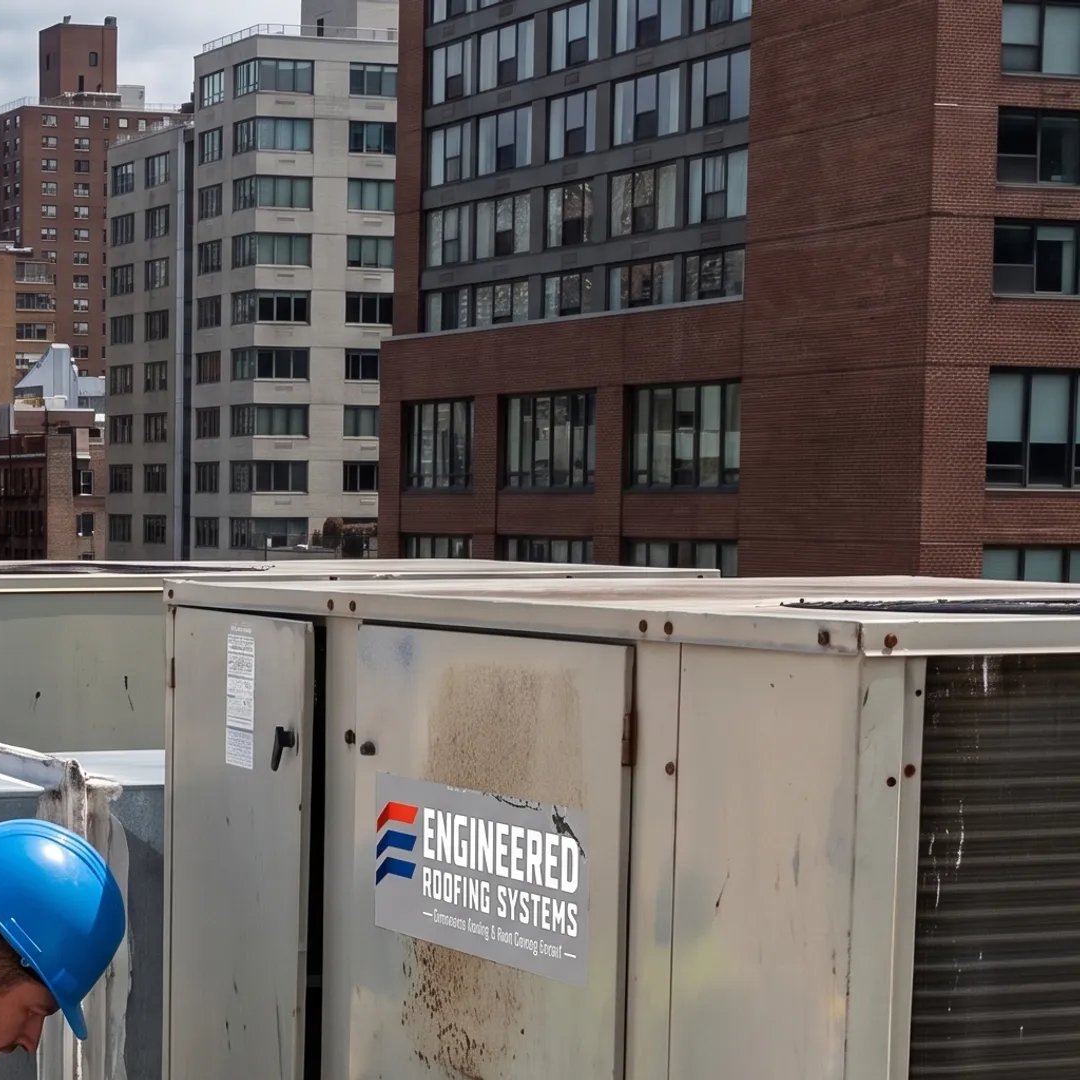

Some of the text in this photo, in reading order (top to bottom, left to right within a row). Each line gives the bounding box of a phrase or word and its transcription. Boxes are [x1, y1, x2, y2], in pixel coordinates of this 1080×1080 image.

[423, 807, 579, 894] ENGINEERED
[422, 867, 491, 914] ROOFING
[497, 886, 578, 938] SYSTEMS
